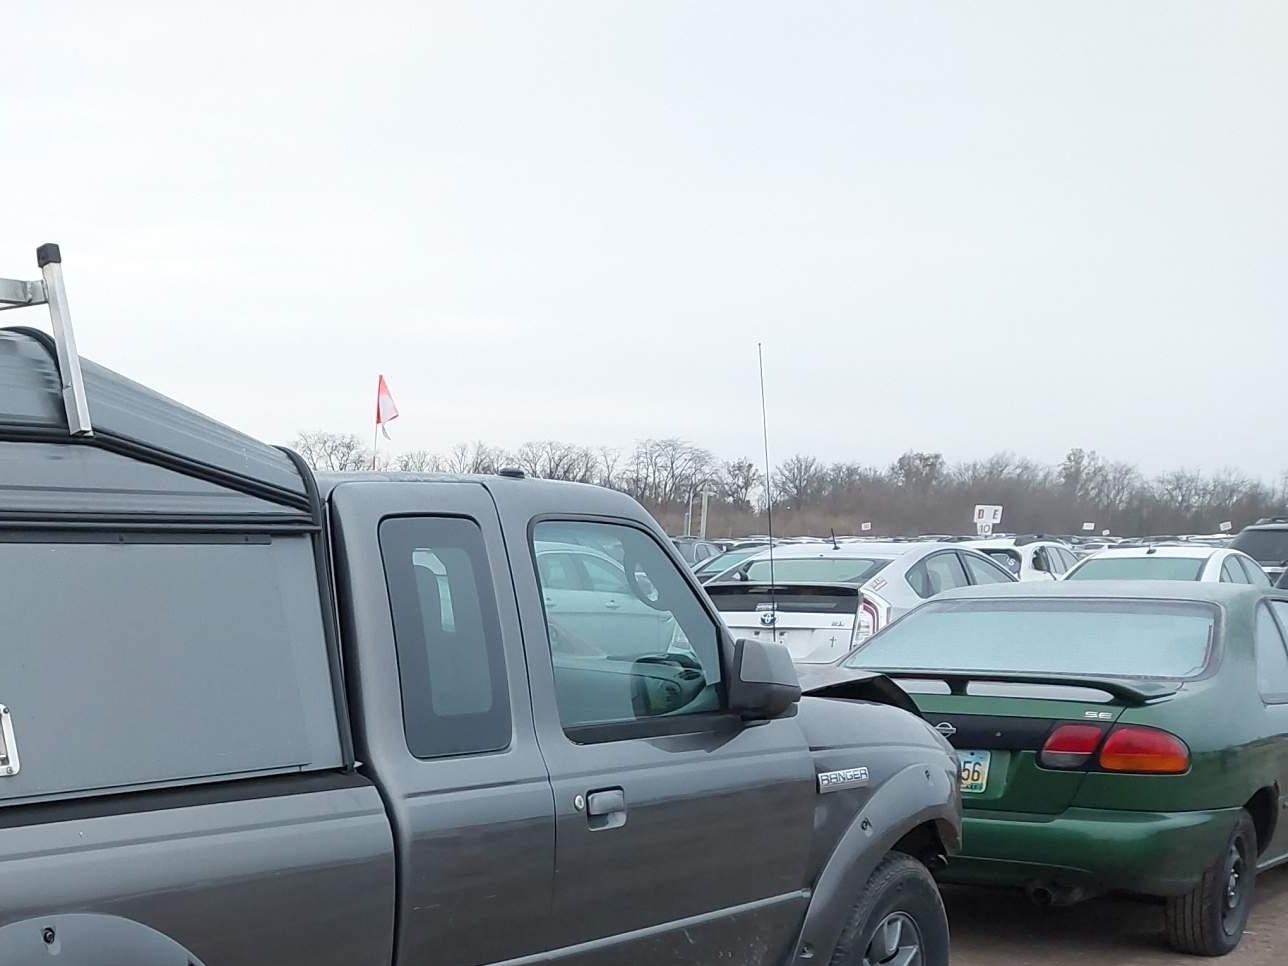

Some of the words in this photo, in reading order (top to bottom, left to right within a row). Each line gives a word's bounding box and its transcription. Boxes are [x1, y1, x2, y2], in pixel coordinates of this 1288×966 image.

[979, 523, 991, 534] 10
[1084, 711, 1113, 719] SE
[819, 767, 868, 786] RANGER
[961, 760, 983, 782] 56
